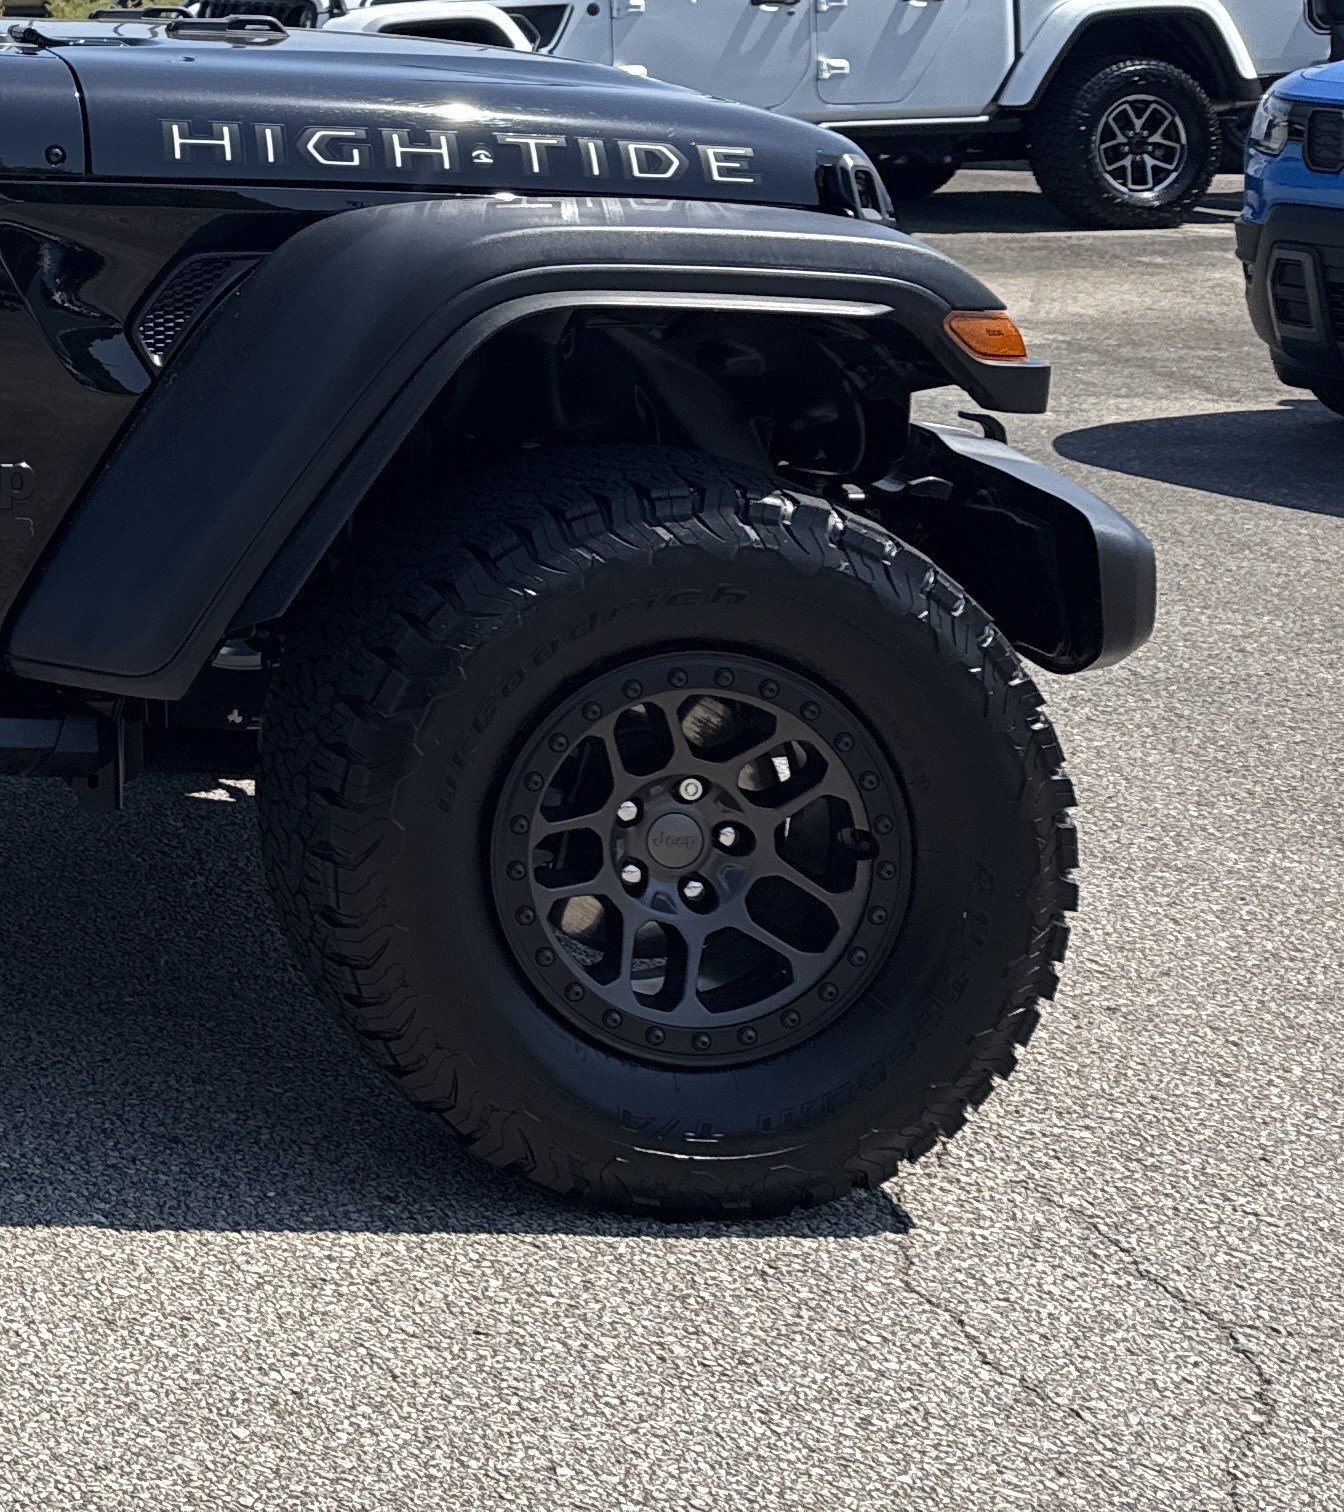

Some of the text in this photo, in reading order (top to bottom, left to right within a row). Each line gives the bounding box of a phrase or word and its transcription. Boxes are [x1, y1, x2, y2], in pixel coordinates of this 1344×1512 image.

[160, 119, 761, 184] HIGH TIDE
[438, 581, 749, 814] BFGoodrich
[652, 831, 697, 850] Jeep
